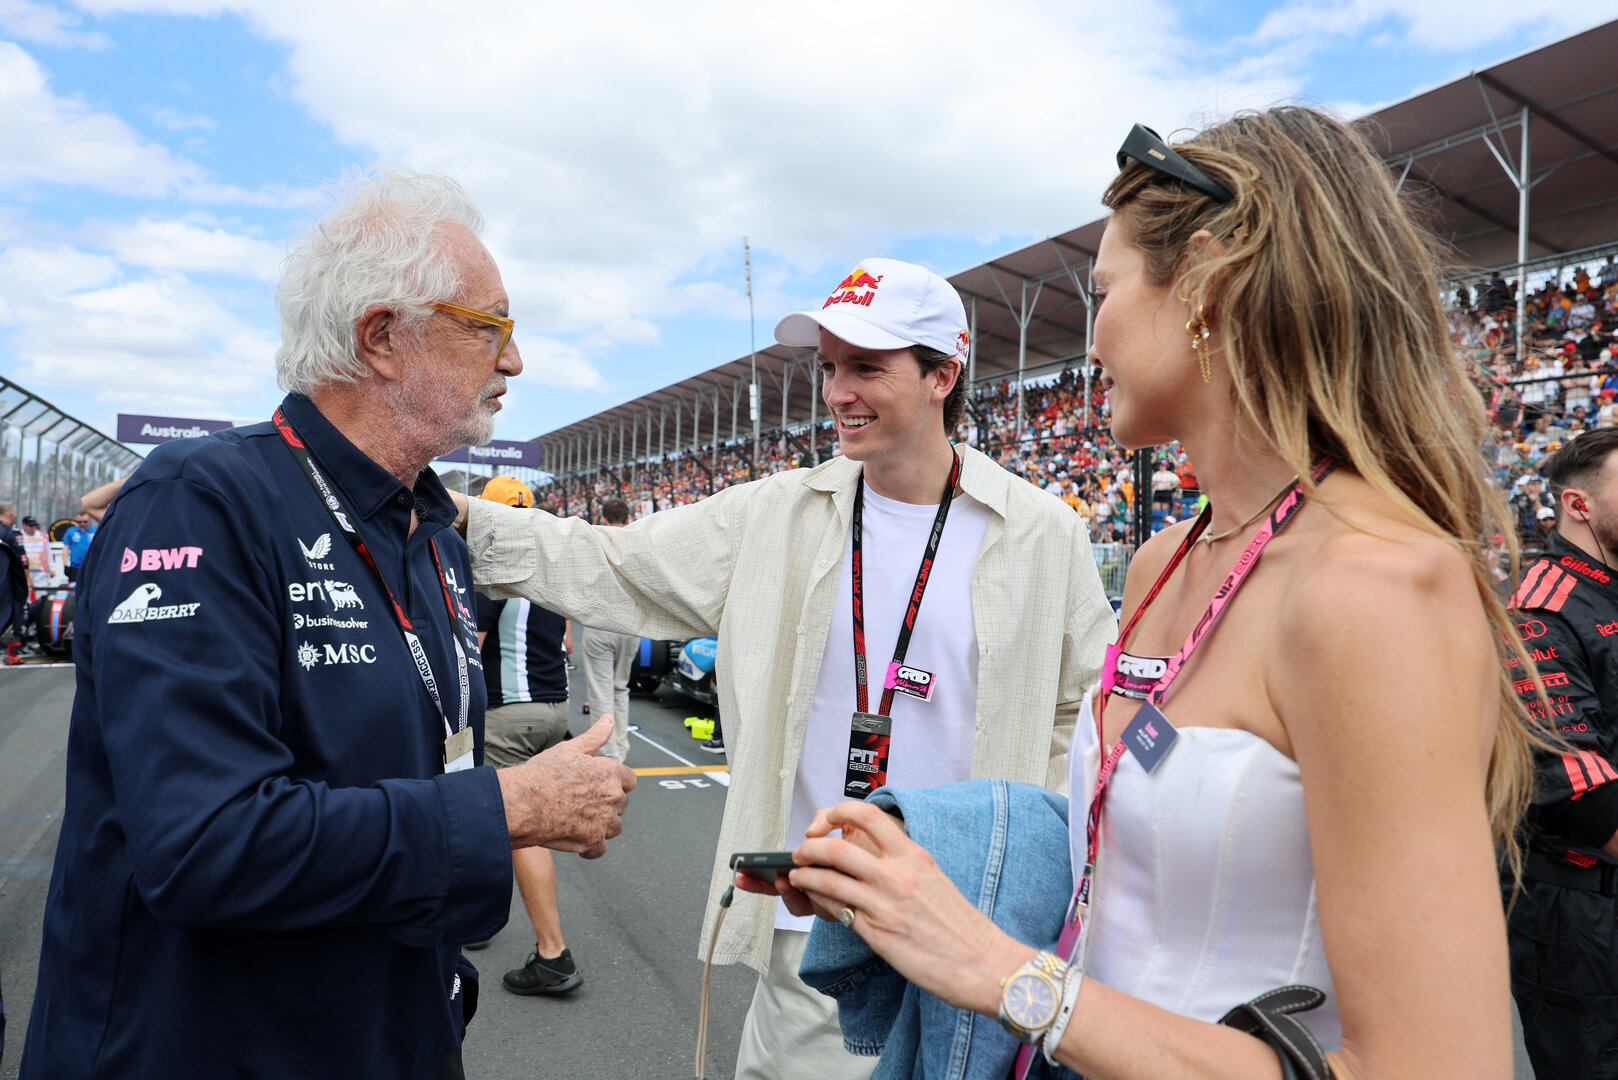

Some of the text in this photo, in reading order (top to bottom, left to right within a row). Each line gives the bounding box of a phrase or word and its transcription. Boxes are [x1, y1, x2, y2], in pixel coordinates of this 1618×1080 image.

[841, 291, 875, 306] Bull
[140, 423, 209, 438] Australia
[469, 446, 523, 459] Australia
[140, 546, 203, 571] BWT
[307, 560, 335, 571] STORE
[1560, 556, 1610, 584] Gillette
[288, 581, 327, 602] en
[1214, 575, 1236, 600] VIP
[110, 603, 200, 620] OAKBERRY
[323, 643, 377, 665] MSC
[410, 639, 440, 701] GRID ACCESS
[857, 654, 866, 686] 2026
[898, 667, 930, 684] GRID
[1512, 672, 1570, 693] IRLLI
[1523, 695, 1570, 709] WORD OF
[1560, 723, 1588, 732] EXO
[850, 748, 879, 764] PIT
[849, 762, 879, 773] 2026
